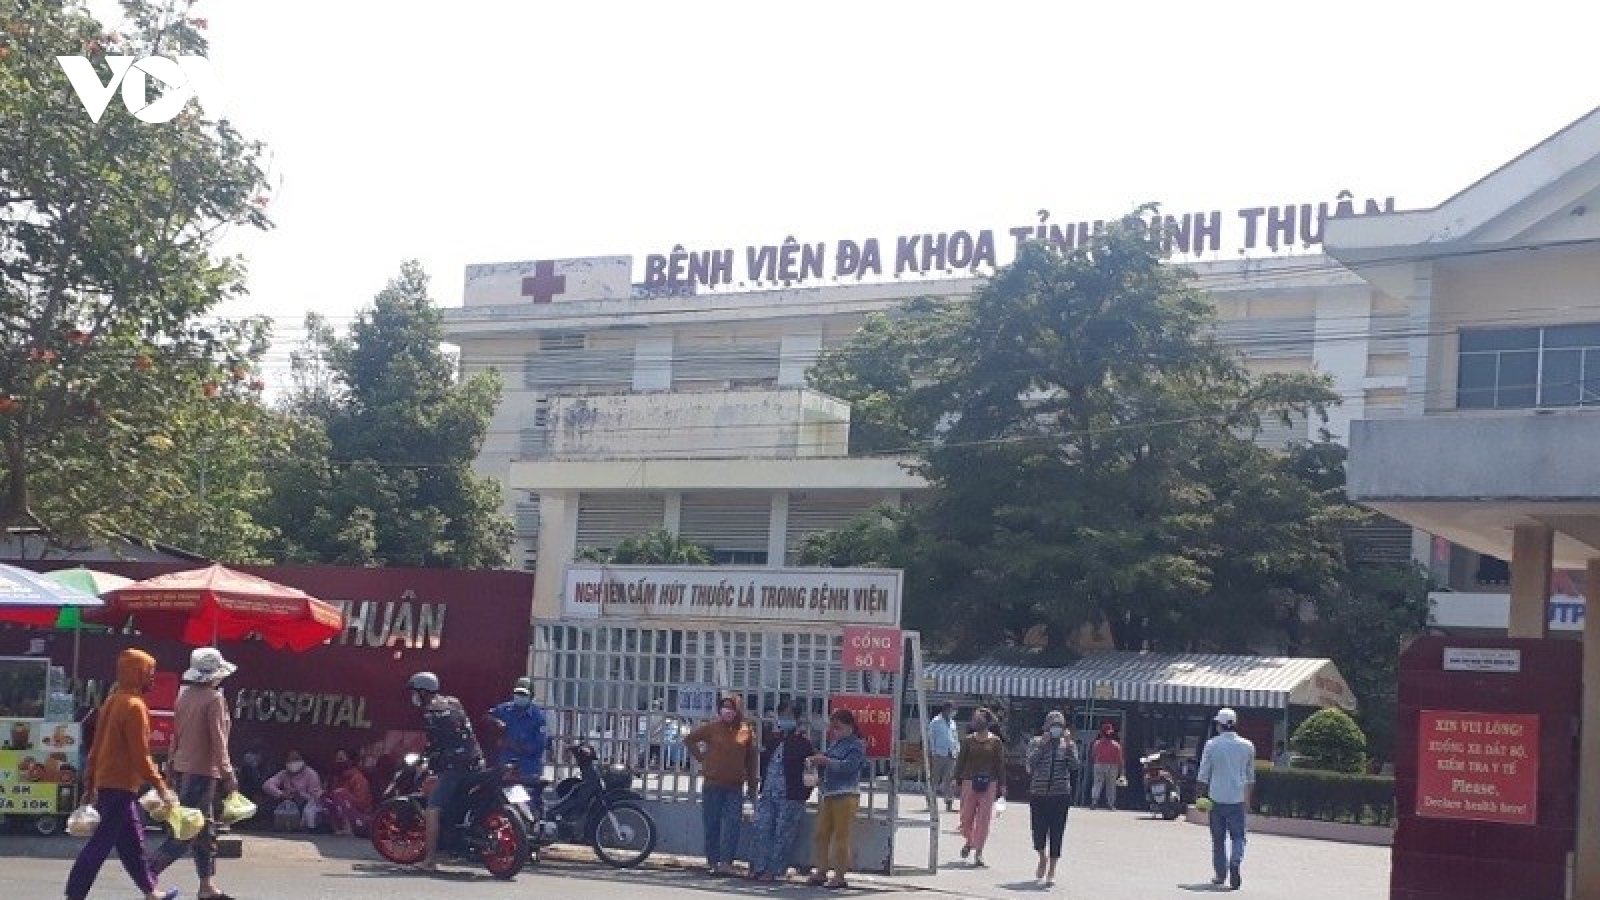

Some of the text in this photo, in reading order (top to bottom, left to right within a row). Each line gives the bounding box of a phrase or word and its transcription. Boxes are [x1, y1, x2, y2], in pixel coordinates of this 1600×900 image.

[748, 235, 825, 287] VIỆN
[836, 238, 882, 277] ĐA
[895, 229, 997, 273] KHOA
[761, 586, 807, 609] TRONG
[323, 589, 447, 661] HUẬN
[234, 688, 372, 729] HOSPITAL
